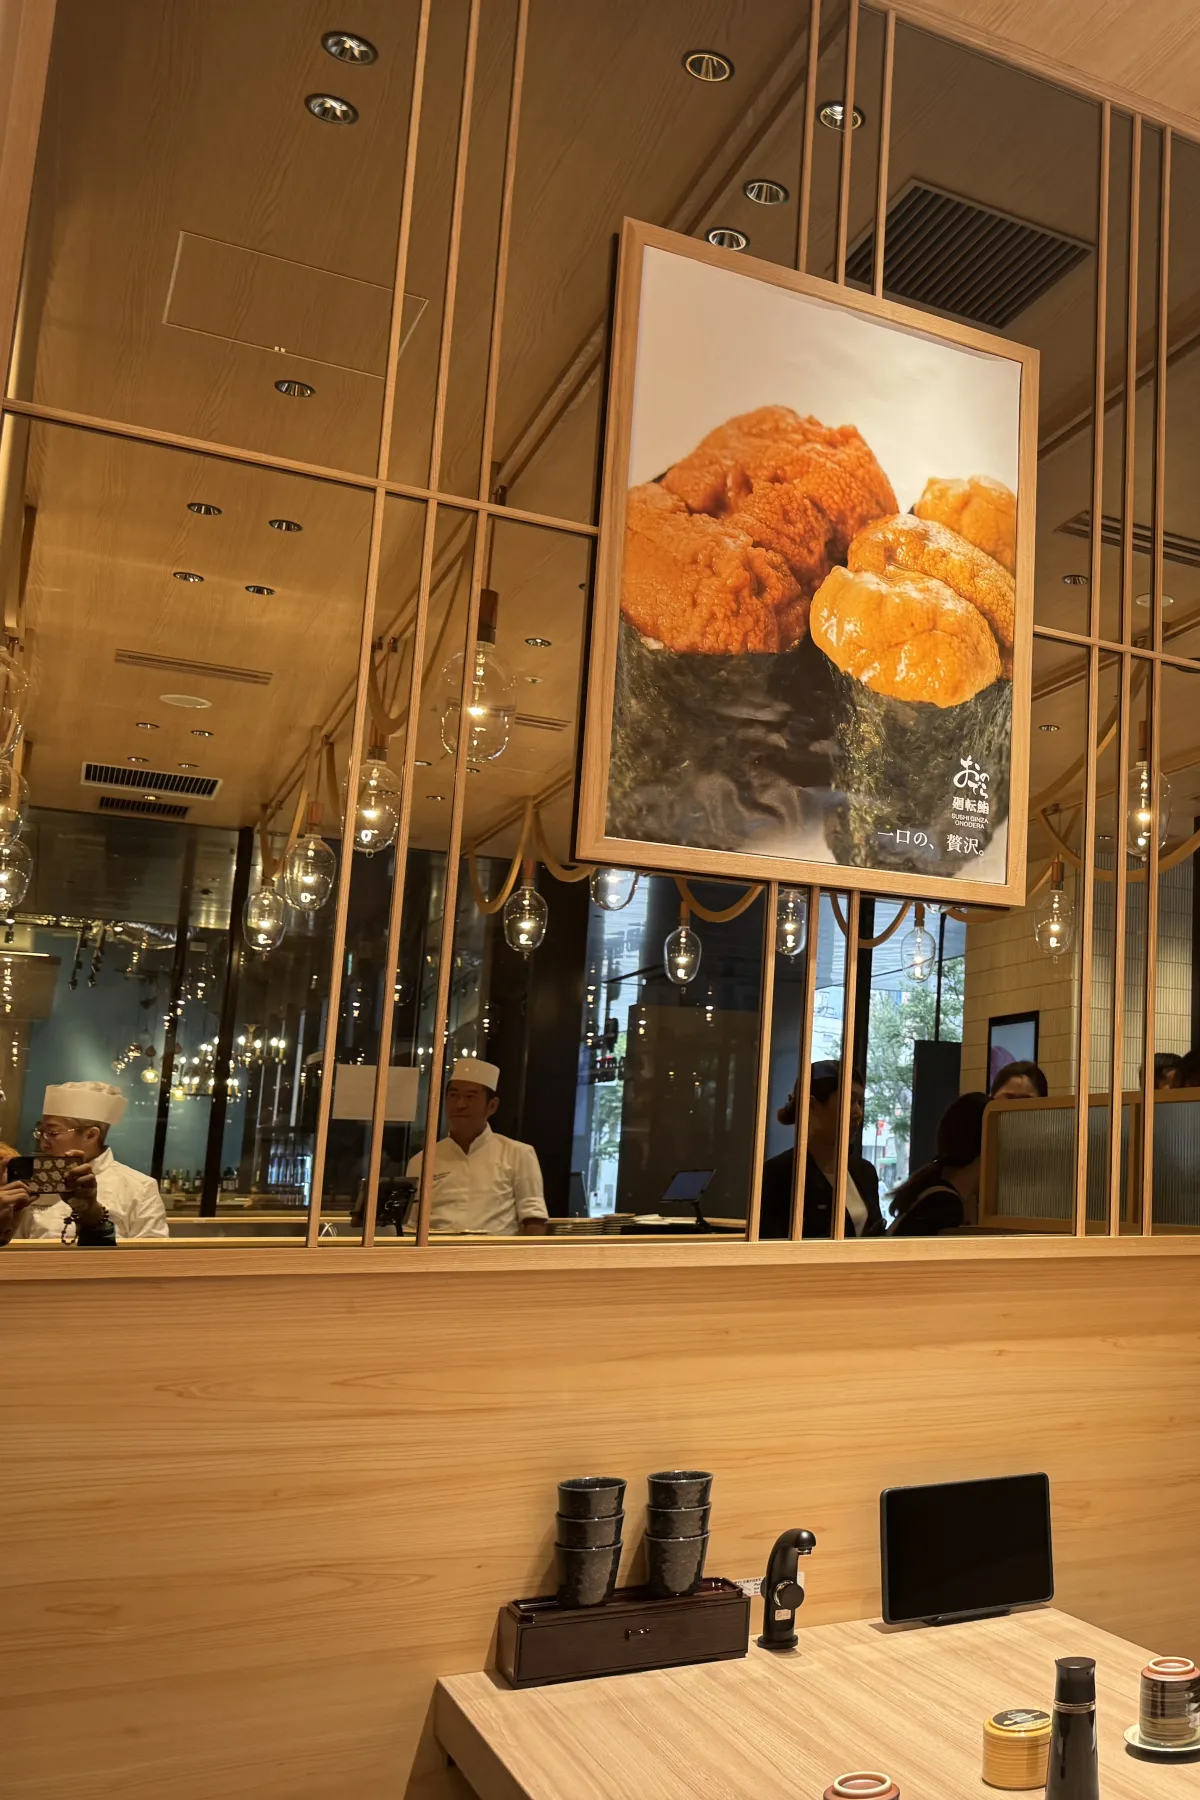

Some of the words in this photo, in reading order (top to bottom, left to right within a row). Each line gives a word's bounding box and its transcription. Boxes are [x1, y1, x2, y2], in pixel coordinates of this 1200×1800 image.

[952, 796, 990, 815] 廻転鮨
[951, 813, 970, 822] SUSHI
[970, 815, 989, 824] GINZA
[954, 820, 986, 830] ONODERA
[946, 834, 985, 857] 贅沢。
